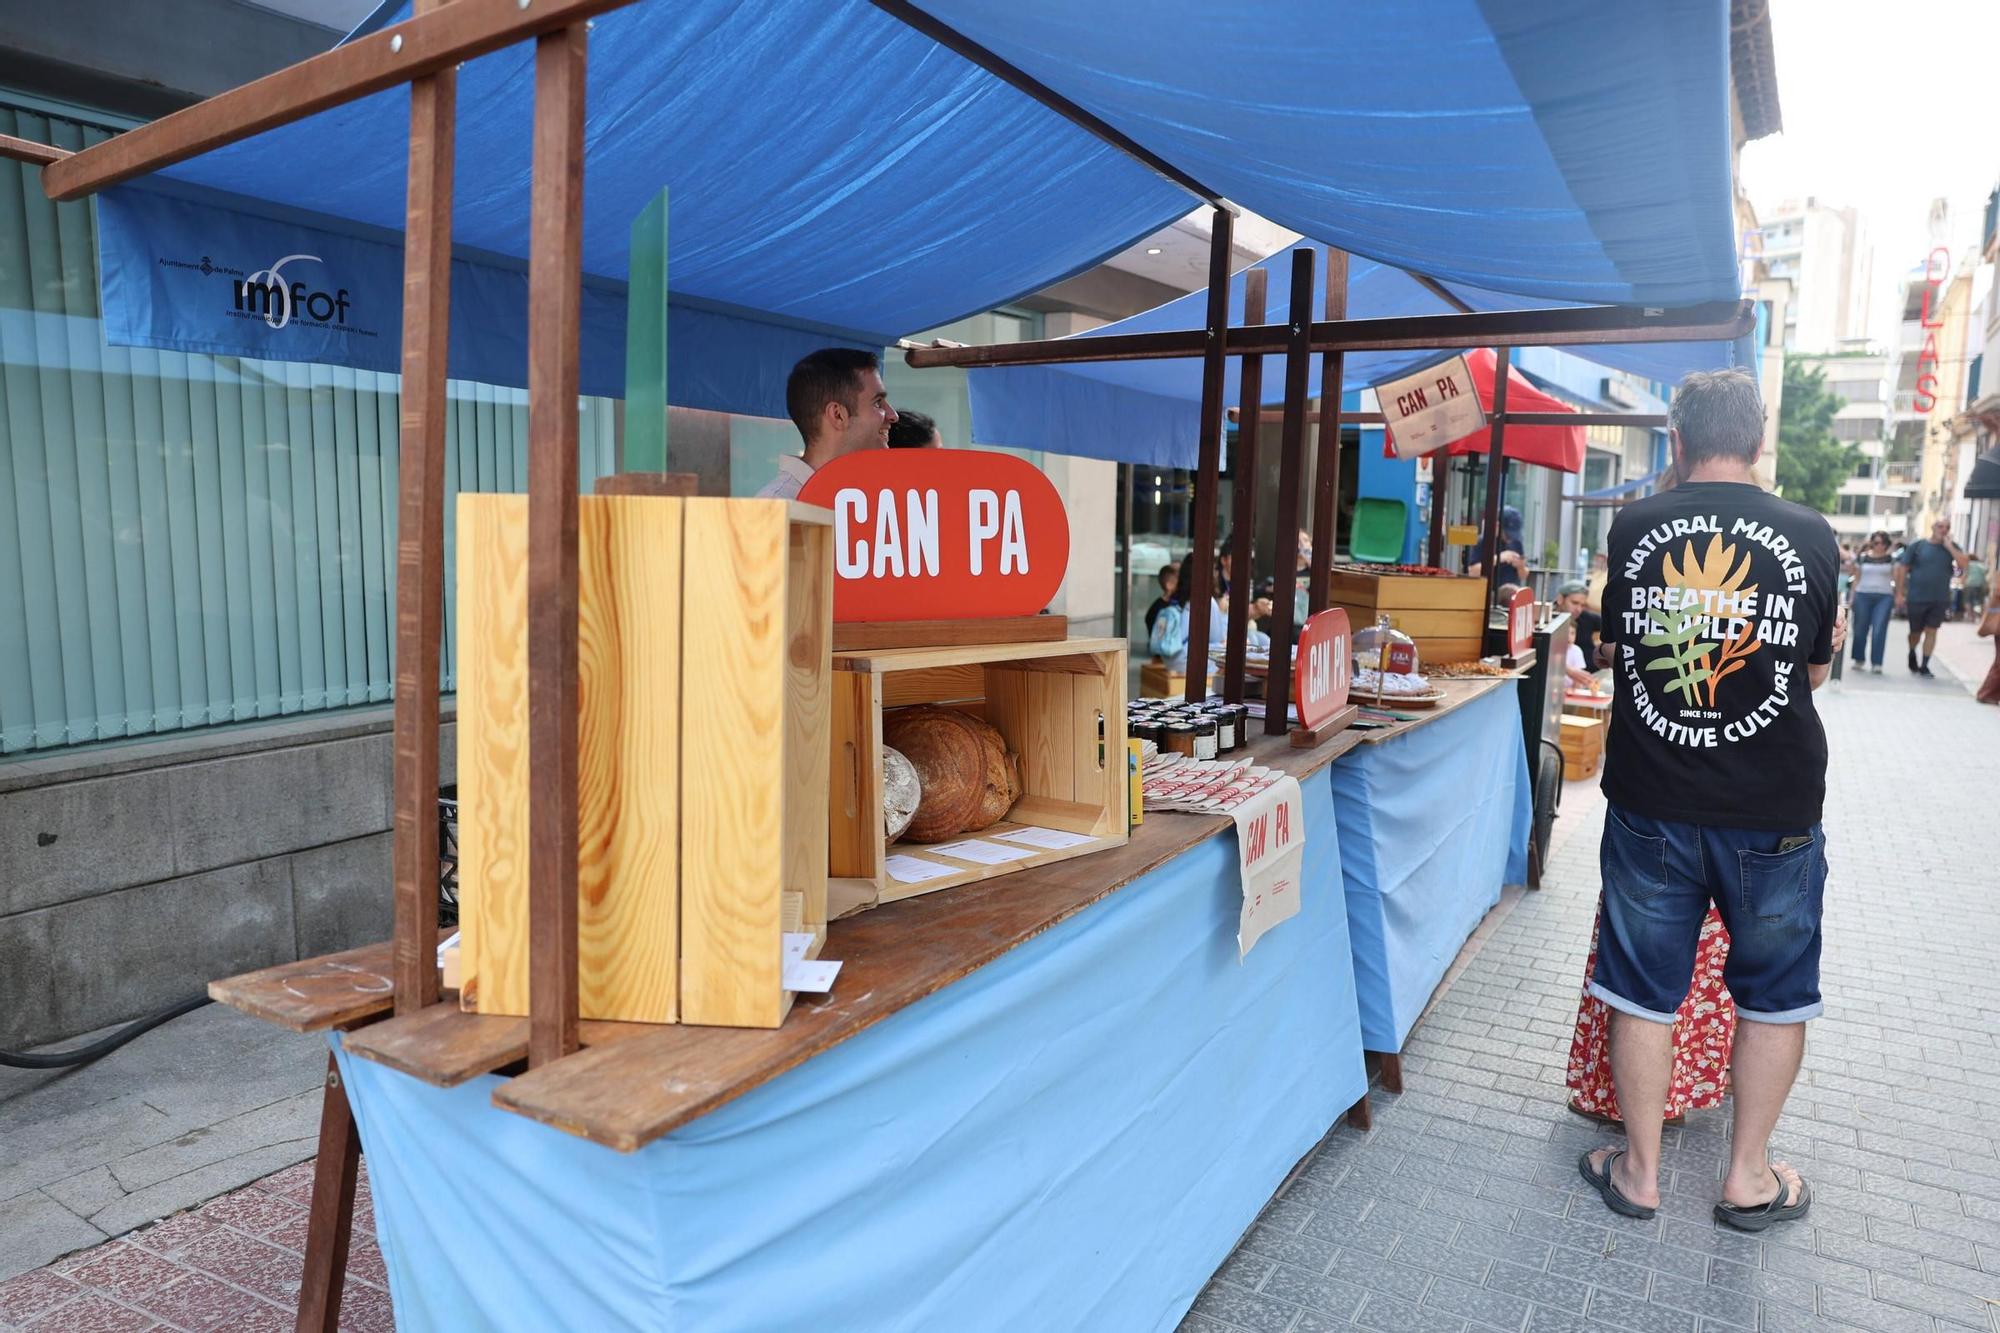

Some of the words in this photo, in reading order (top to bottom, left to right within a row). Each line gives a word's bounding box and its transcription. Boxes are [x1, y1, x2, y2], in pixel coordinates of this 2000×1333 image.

[159, 258, 200, 270] Ajuntament
[224, 267, 244, 277] Palma
[1397, 387, 1428, 417] CAN
[1436, 376, 1459, 400] PA
[834, 488, 940, 579] CAN
[968, 489, 1029, 576] PA
[1624, 515, 1723, 580] NATURAL
[1730, 518, 1807, 594] MARKET
[1622, 612, 1666, 635] THE
[1757, 619, 1799, 647] AIR
[1631, 586, 1758, 616] BREATHE
[1764, 593, 1795, 620] IN
[1310, 640, 1330, 704] CAN
[1334, 634, 1345, 691] PA
[1622, 644, 1717, 748] ALTERNATIVE
[1724, 660, 1793, 742] CULTURE
[1679, 709, 1701, 718] SINCE
[1702, 711, 1722, 719] 1991
[1246, 812, 1267, 868] CAN
[1275, 801, 1289, 848] PA
